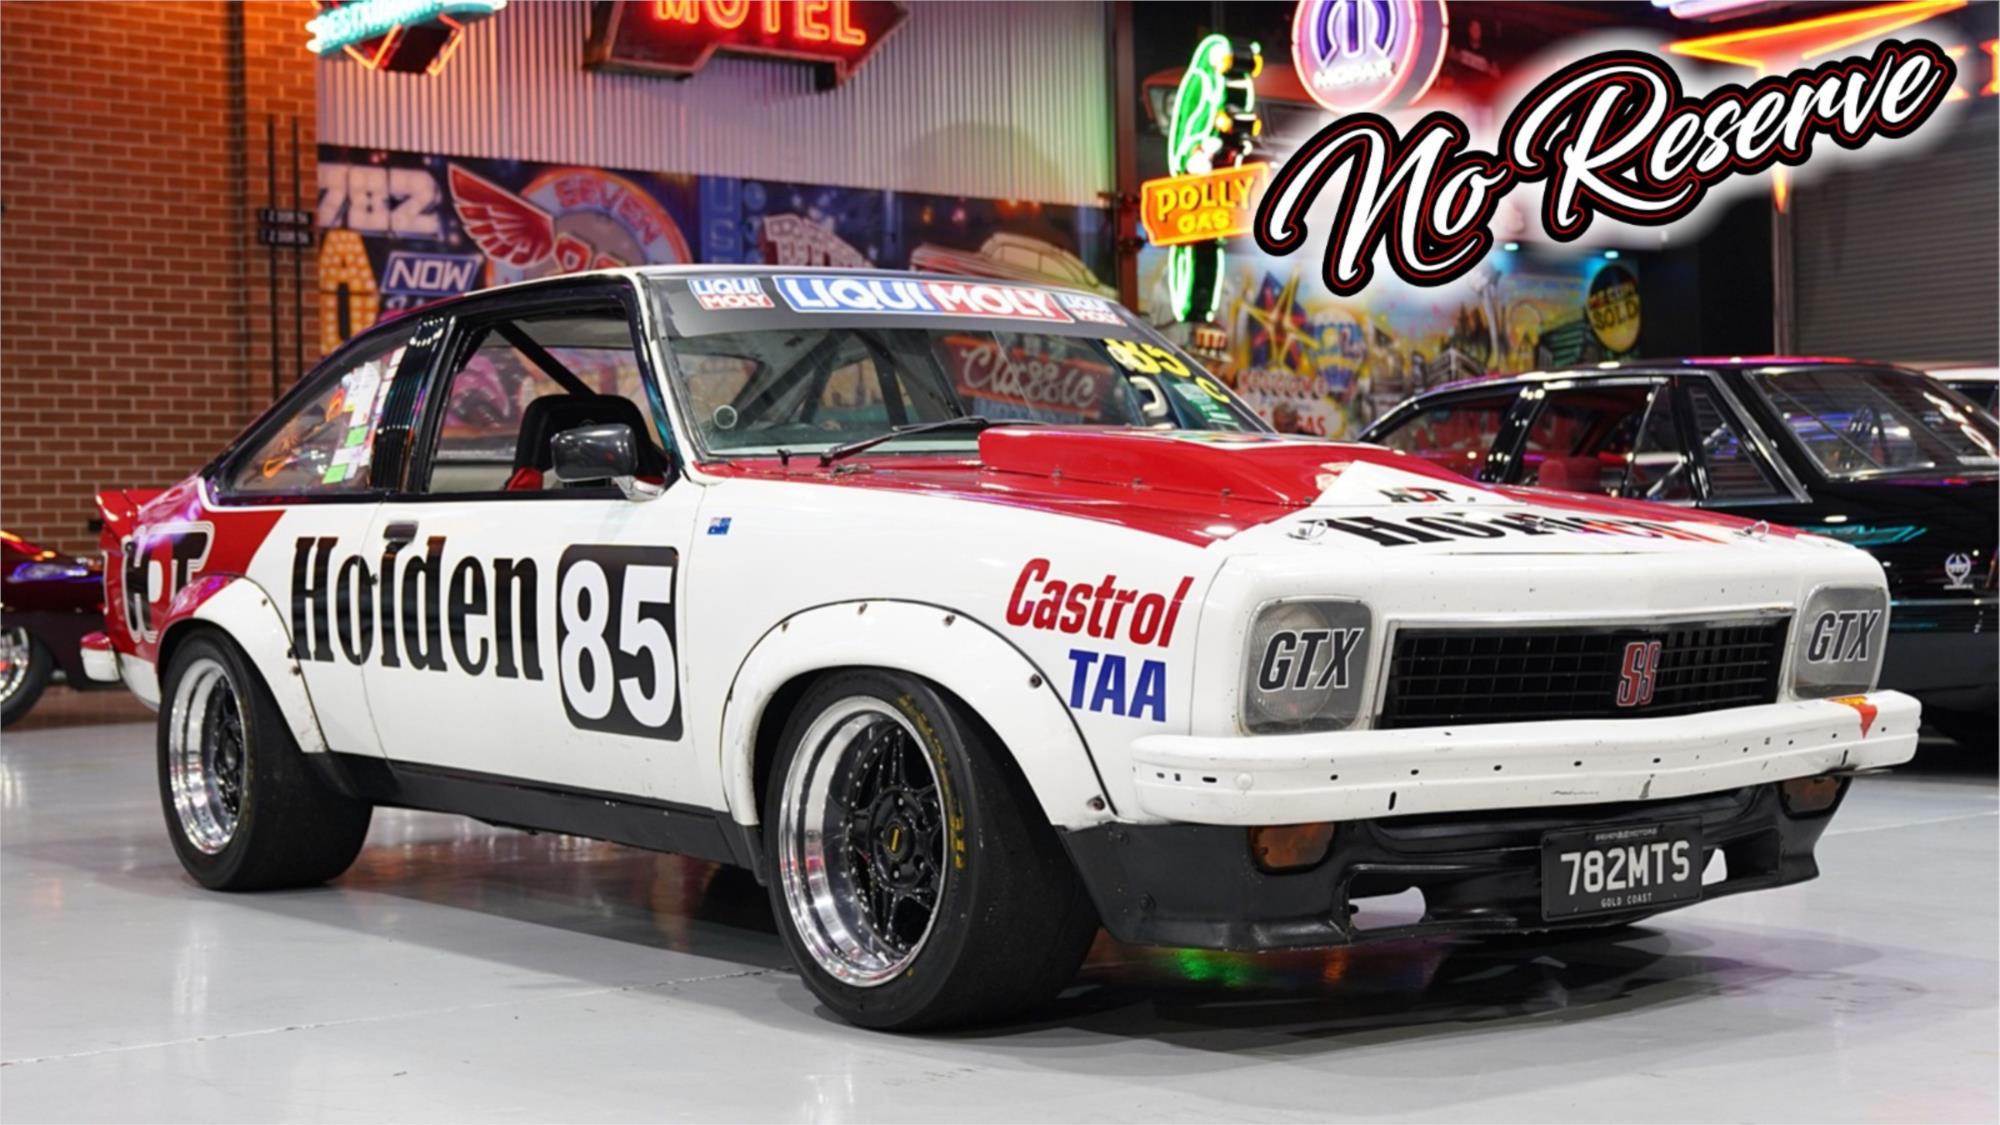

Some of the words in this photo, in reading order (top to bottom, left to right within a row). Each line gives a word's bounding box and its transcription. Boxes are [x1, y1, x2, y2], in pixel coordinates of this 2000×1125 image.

[1314, 58, 1393, 91] MOPAR
[1156, 176, 1255, 221] POLLY
[1177, 208, 1230, 234] GAS
[388, 258, 473, 291] NOW
[692, 279, 758, 295] LIQUI
[701, 294, 770, 309] MOLY
[785, 279, 935, 310] LIQUI
[927, 283, 1057, 318] MOLY
[1592, 298, 1638, 330] SOLD
[112, 520, 215, 644] HOT
[1005, 558, 1195, 648] Castrol
[289, 536, 545, 682] Holden
[560, 558, 677, 729] 85
[1807, 609, 1882, 664] GTX
[1257, 627, 1365, 693] GTX
[1616, 641, 1662, 707] SS
[1068, 648, 1167, 723] TAA
[1560, 840, 1690, 896] 782MTS
[1600, 896, 1622, 908] GOLD
[1626, 892, 1652, 905] COAST
